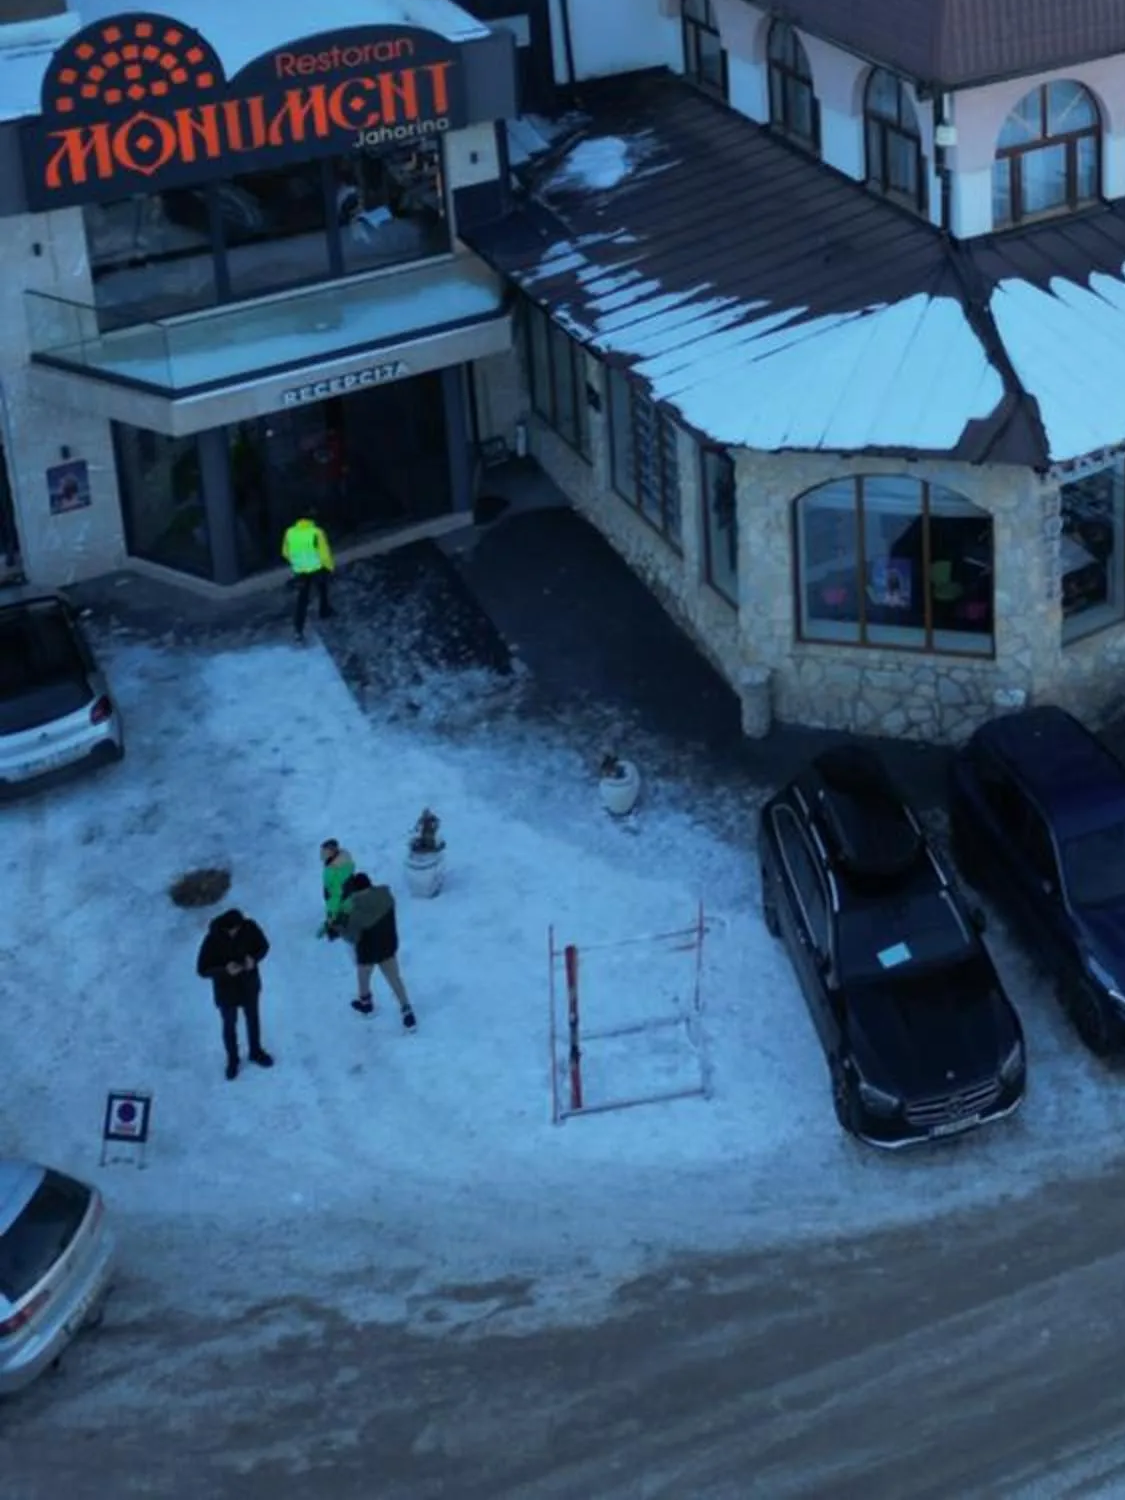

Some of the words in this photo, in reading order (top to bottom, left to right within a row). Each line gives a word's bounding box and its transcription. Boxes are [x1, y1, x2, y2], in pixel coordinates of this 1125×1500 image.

[276, 37, 413, 79] Restoran
[45, 60, 455, 188] MONUMENT
[353, 117, 450, 149] Jahorina
